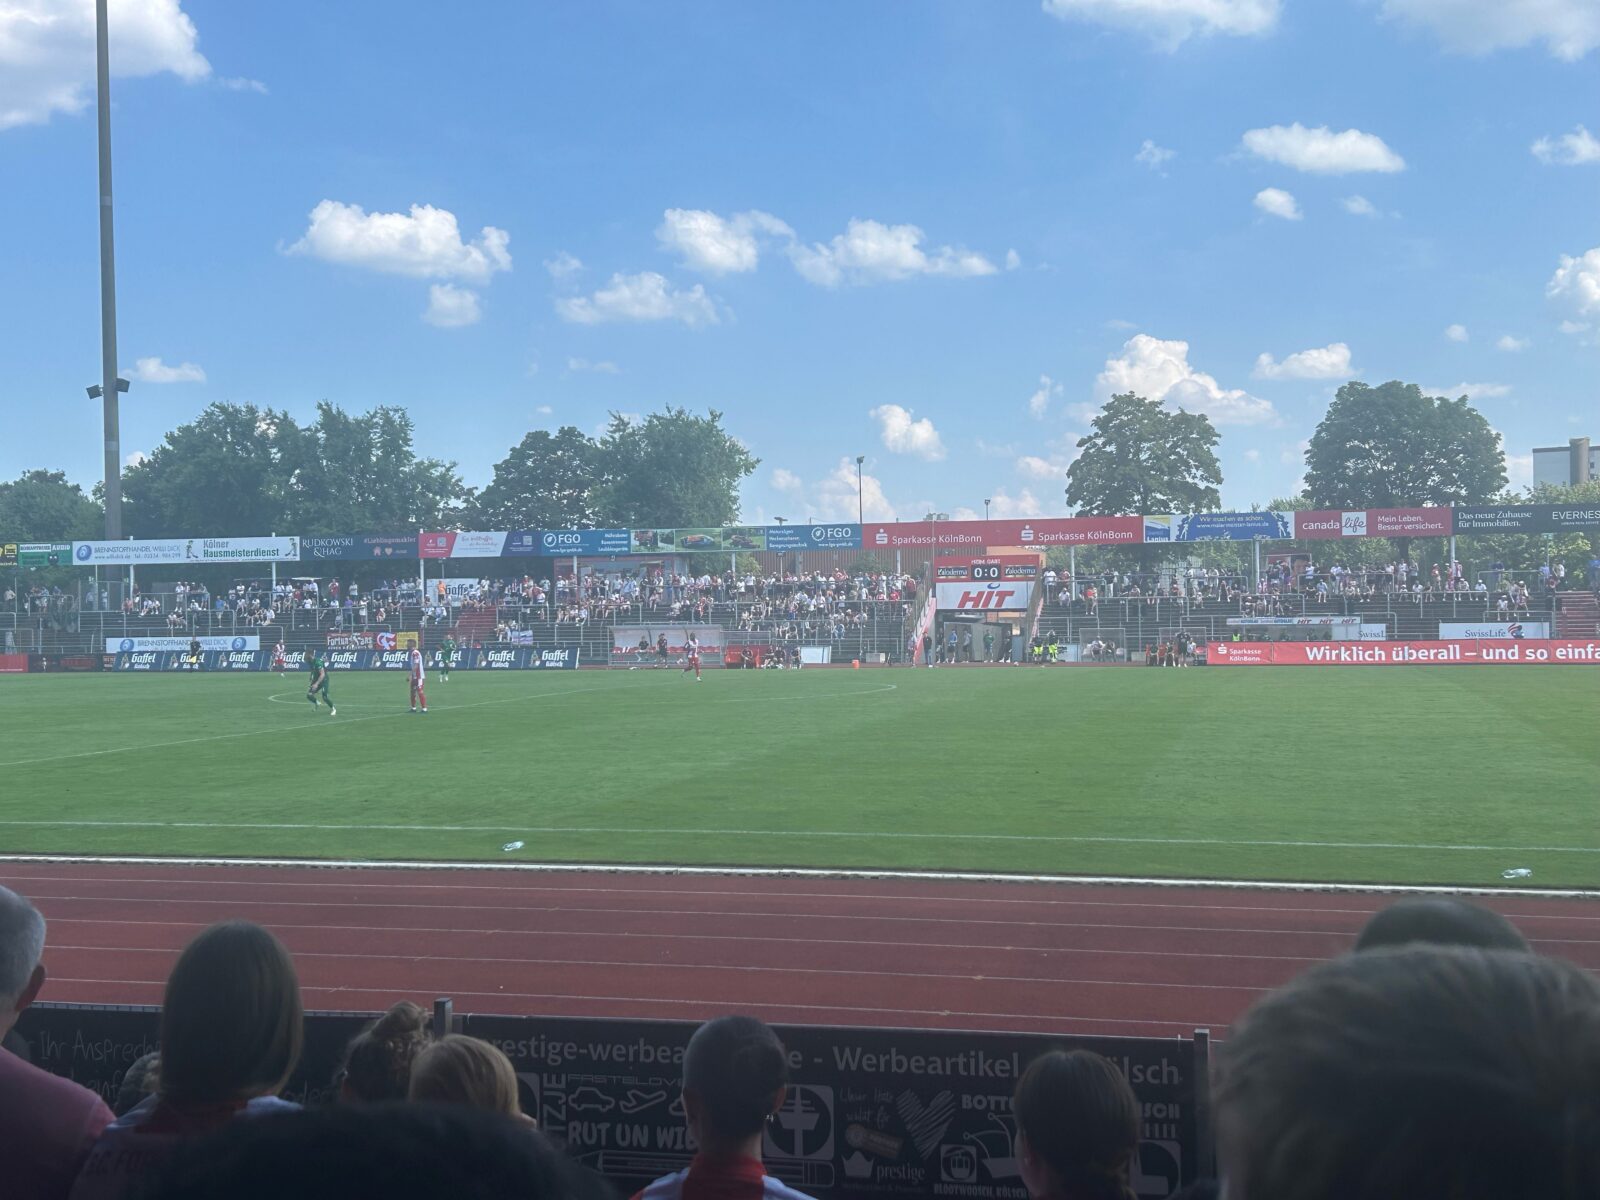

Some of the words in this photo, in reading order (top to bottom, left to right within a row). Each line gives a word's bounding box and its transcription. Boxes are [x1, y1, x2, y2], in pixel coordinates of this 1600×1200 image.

[1302, 520, 1340, 530] canada
[1342, 517, 1366, 533] life
[828, 528, 851, 538] FGO
[1038, 531, 1084, 542] Sparkasse
[1088, 531, 1133, 540] KölnBonn
[302, 538, 353, 548] RUDKOWSKI
[558, 534, 580, 543] FGO
[892, 535, 936, 545] Sparkasse
[938, 535, 982, 543] KölnBonn
[204, 540, 229, 548] Kölner
[204, 548, 279, 558] Hausmeisterdienst
[957, 590, 1015, 608] HIT
[1465, 629, 1506, 638] SwissLife
[229, 652, 255, 662] Gaffel
[331, 652, 357, 662] Gaffel
[383, 652, 409, 662] Gaffel
[488, 650, 515, 660] Gaffel
[542, 650, 568, 660] Gaffel
[1305, 645, 1386, 661] Wirklich
[1392, 644, 1460, 661] überall
[1483, 644, 1518, 660] und
[1526, 648, 1548, 660] so
[132, 653, 156, 663] Gaffel
[40, 1030, 67, 1060] Ihr
[832, 1046, 1018, 1077] Werbeartikel
[568, 1120, 611, 1146] RUT
[616, 1124, 648, 1148] UN
[877, 1162, 925, 1185] prestige
